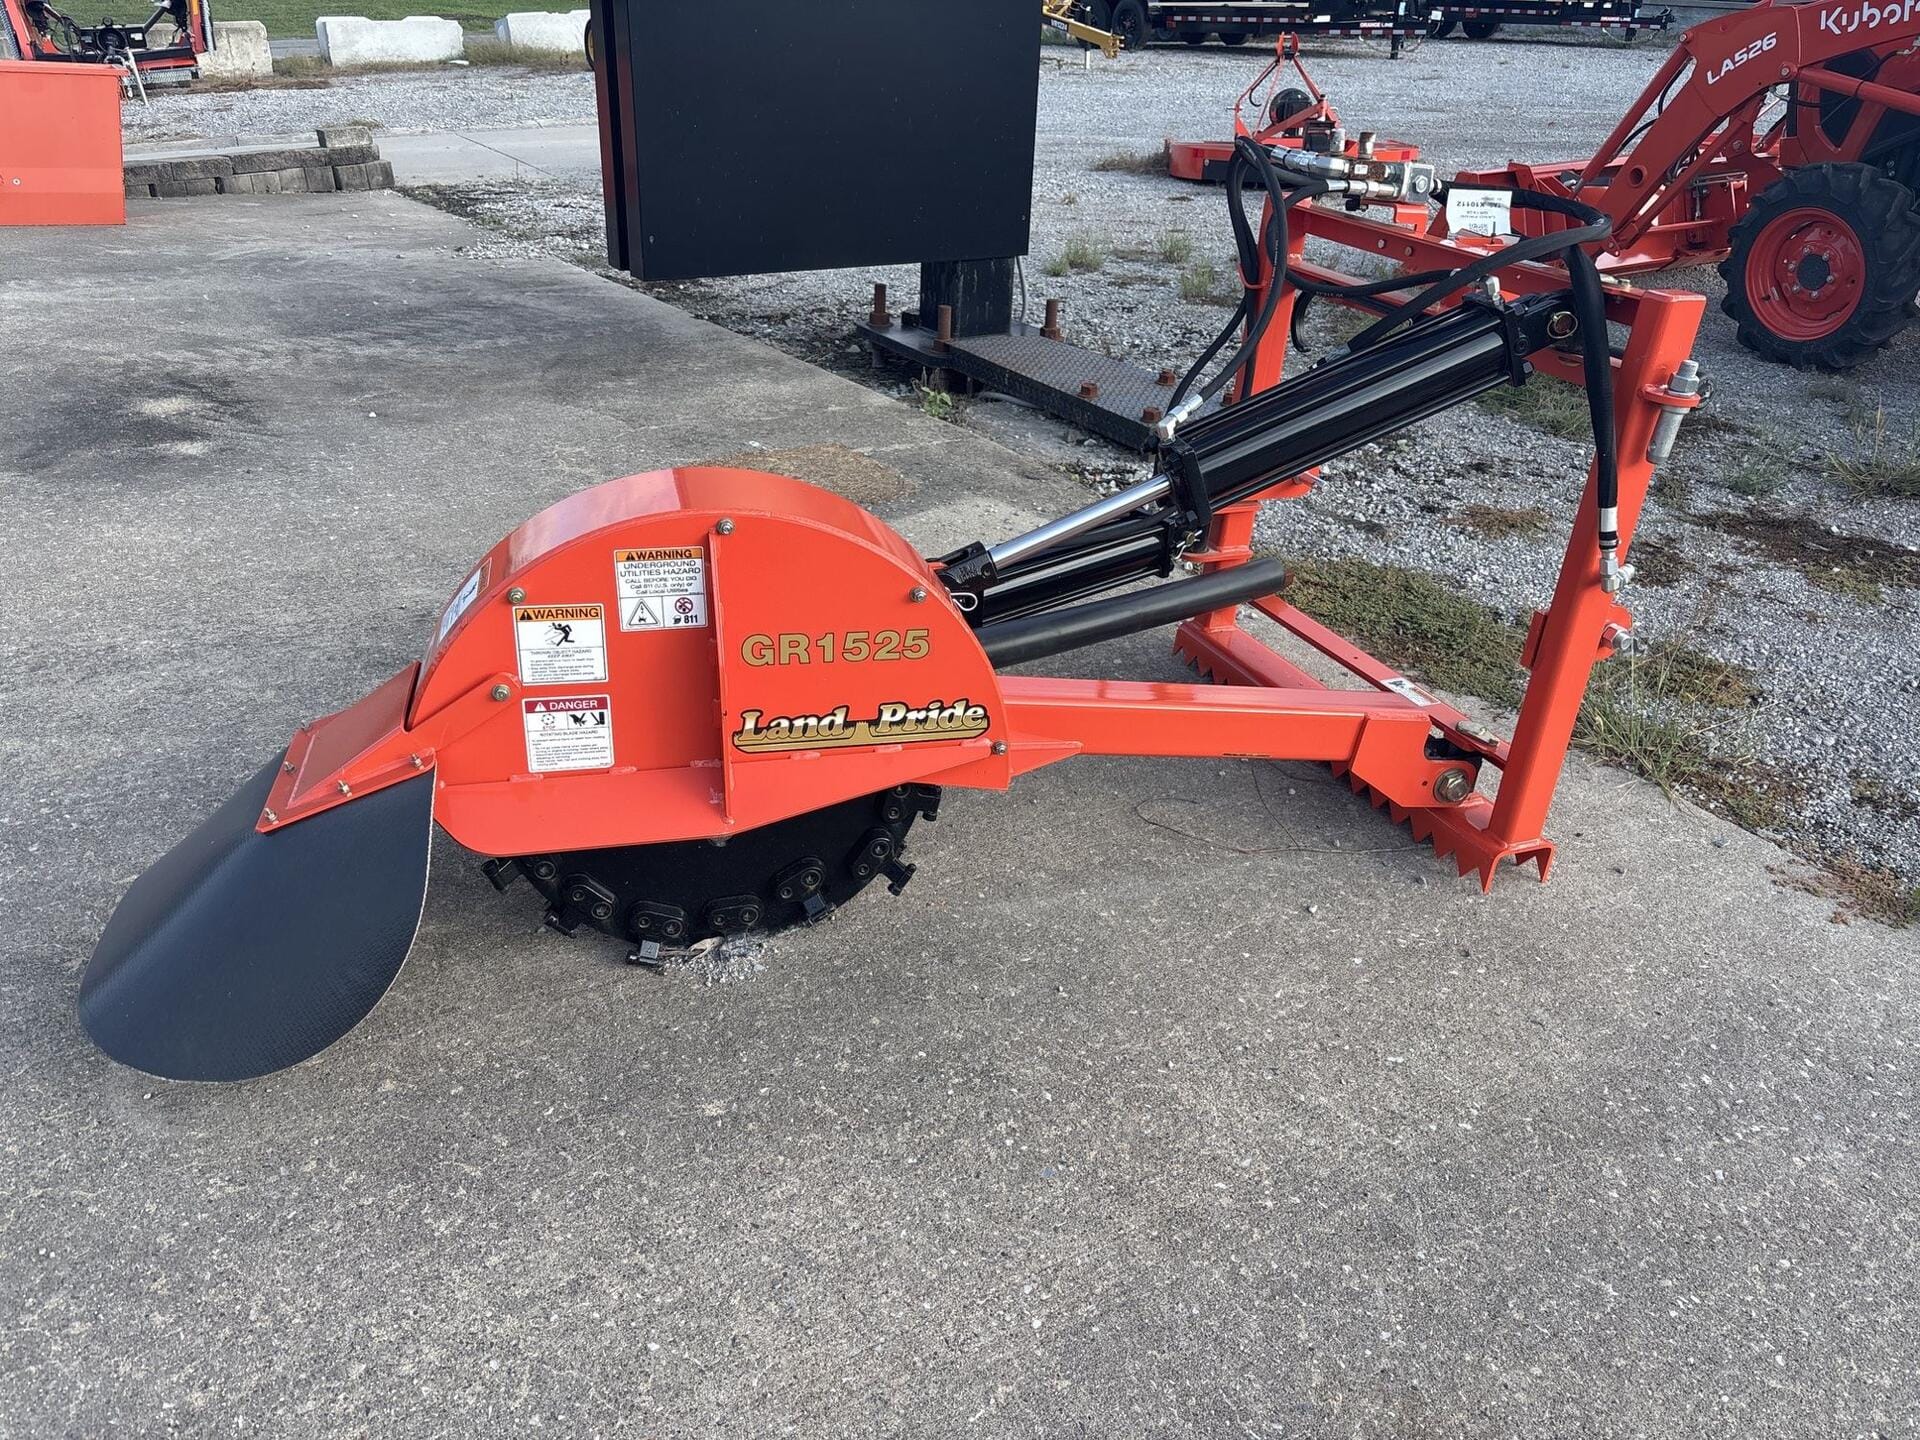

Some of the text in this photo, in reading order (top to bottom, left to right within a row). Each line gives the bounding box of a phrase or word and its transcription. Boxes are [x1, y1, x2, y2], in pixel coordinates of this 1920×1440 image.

[1820, 0, 1920, 35] Kubot
[1706, 31, 1778, 85] LA526
[635, 549, 692, 560] WARNING
[623, 560, 696, 570] UNDERGROUND
[619, 567, 701, 577] UTILITIES HAZARD
[532, 607, 599, 620] WARNING
[683, 614, 698, 624] 811
[741, 628, 930, 667] GR1525
[549, 699, 598, 710] DANGER
[737, 697, 988, 743] Land Pride
